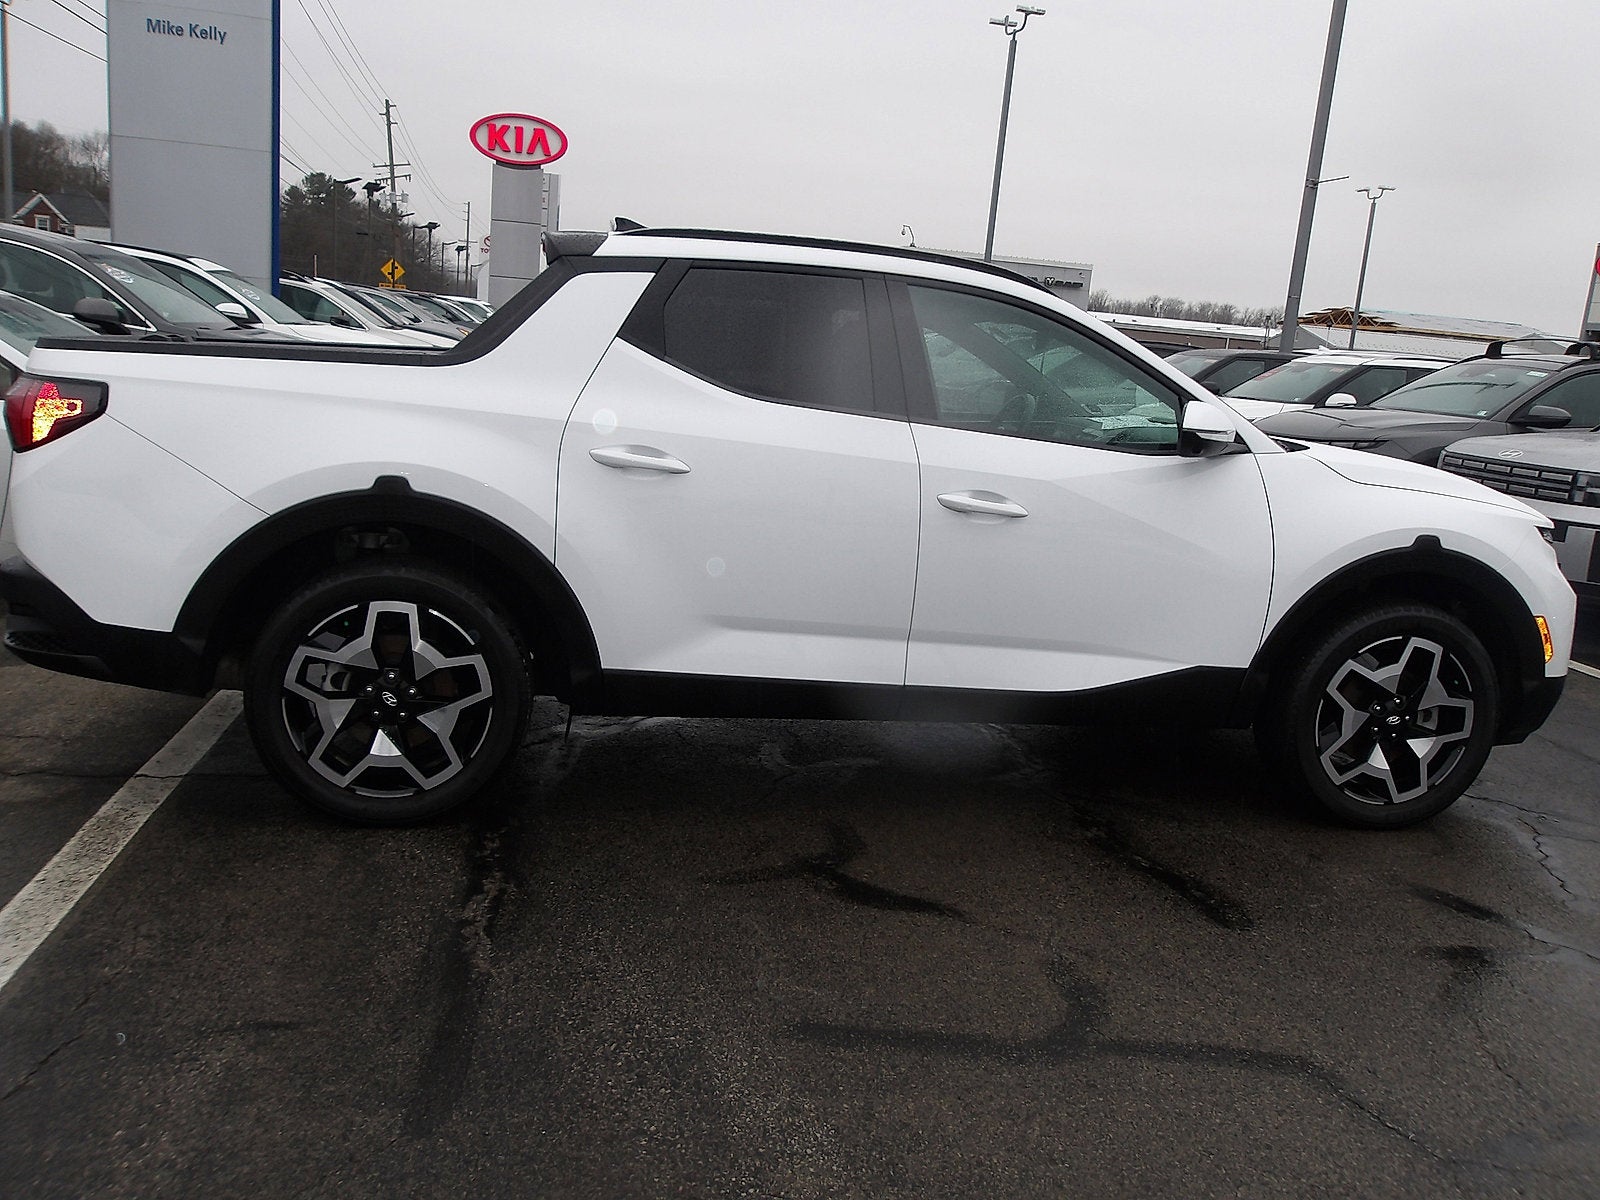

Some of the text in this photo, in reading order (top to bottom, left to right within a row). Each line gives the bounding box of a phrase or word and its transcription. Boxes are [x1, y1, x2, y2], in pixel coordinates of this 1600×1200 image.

[146, 18, 227, 45] Mike Kelly
[487, 122, 552, 156] KIA
